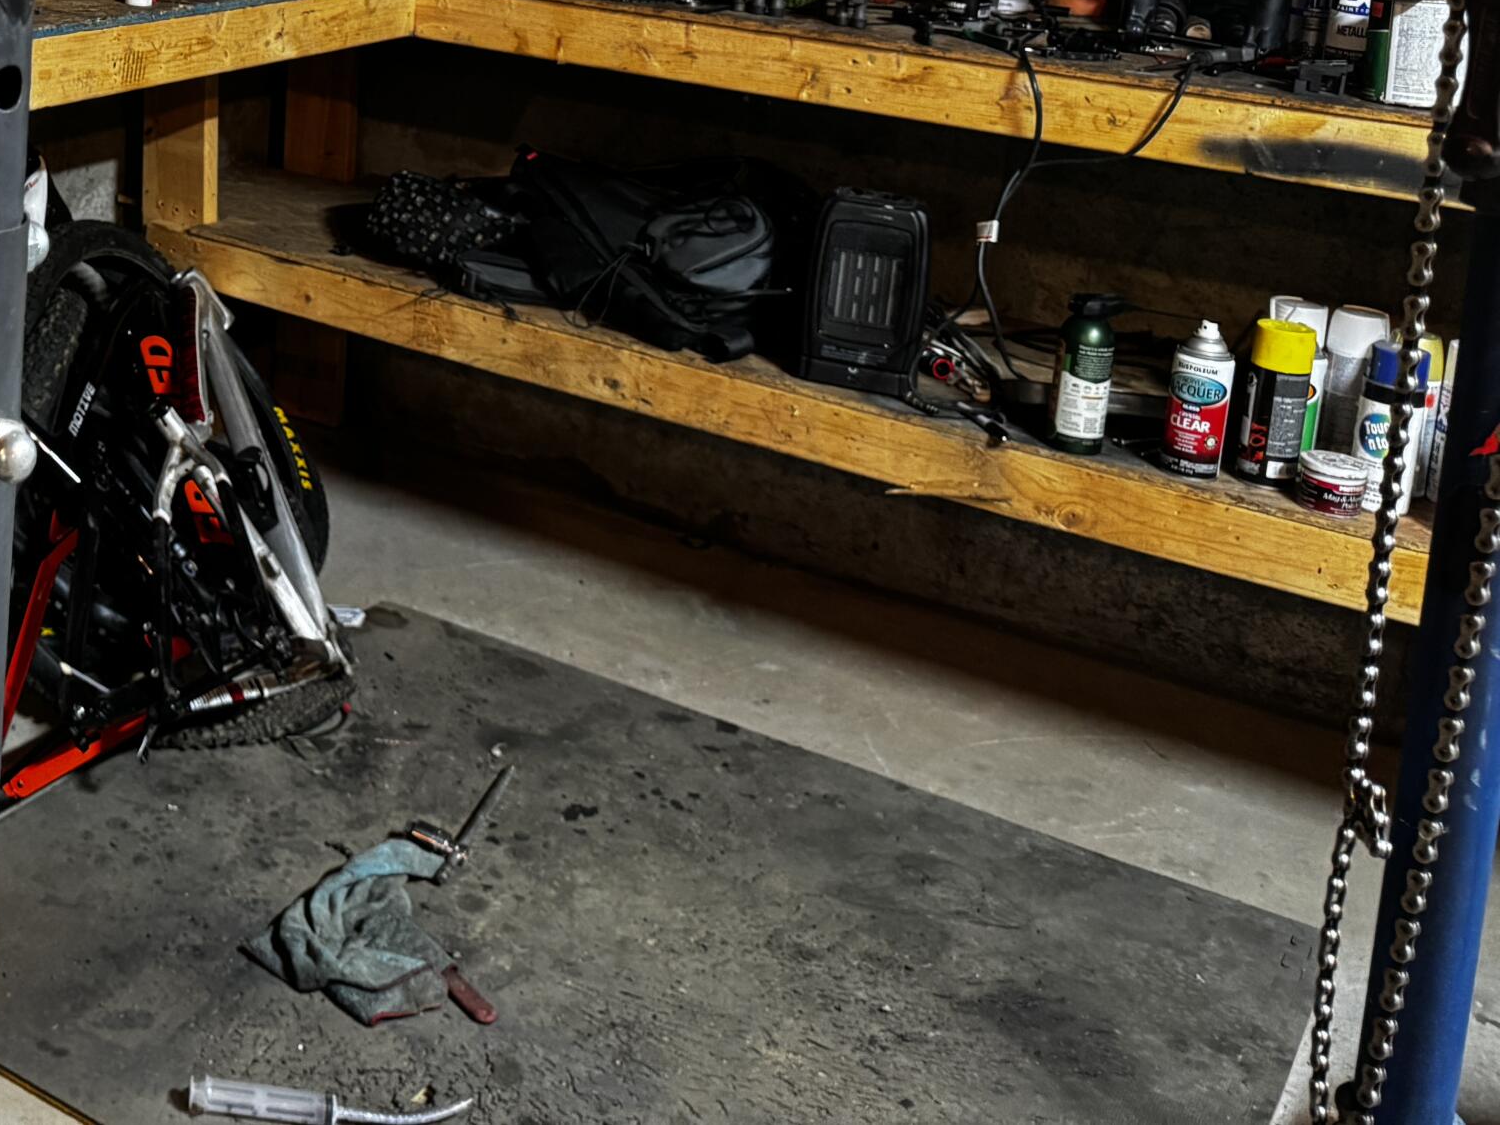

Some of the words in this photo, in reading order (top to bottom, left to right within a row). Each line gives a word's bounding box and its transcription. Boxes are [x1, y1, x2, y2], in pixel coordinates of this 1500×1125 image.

[68, 381, 96, 438] MOTIVE
[1170, 414, 1211, 433] CLEAR
[272, 406, 313, 491] MAXXIS
